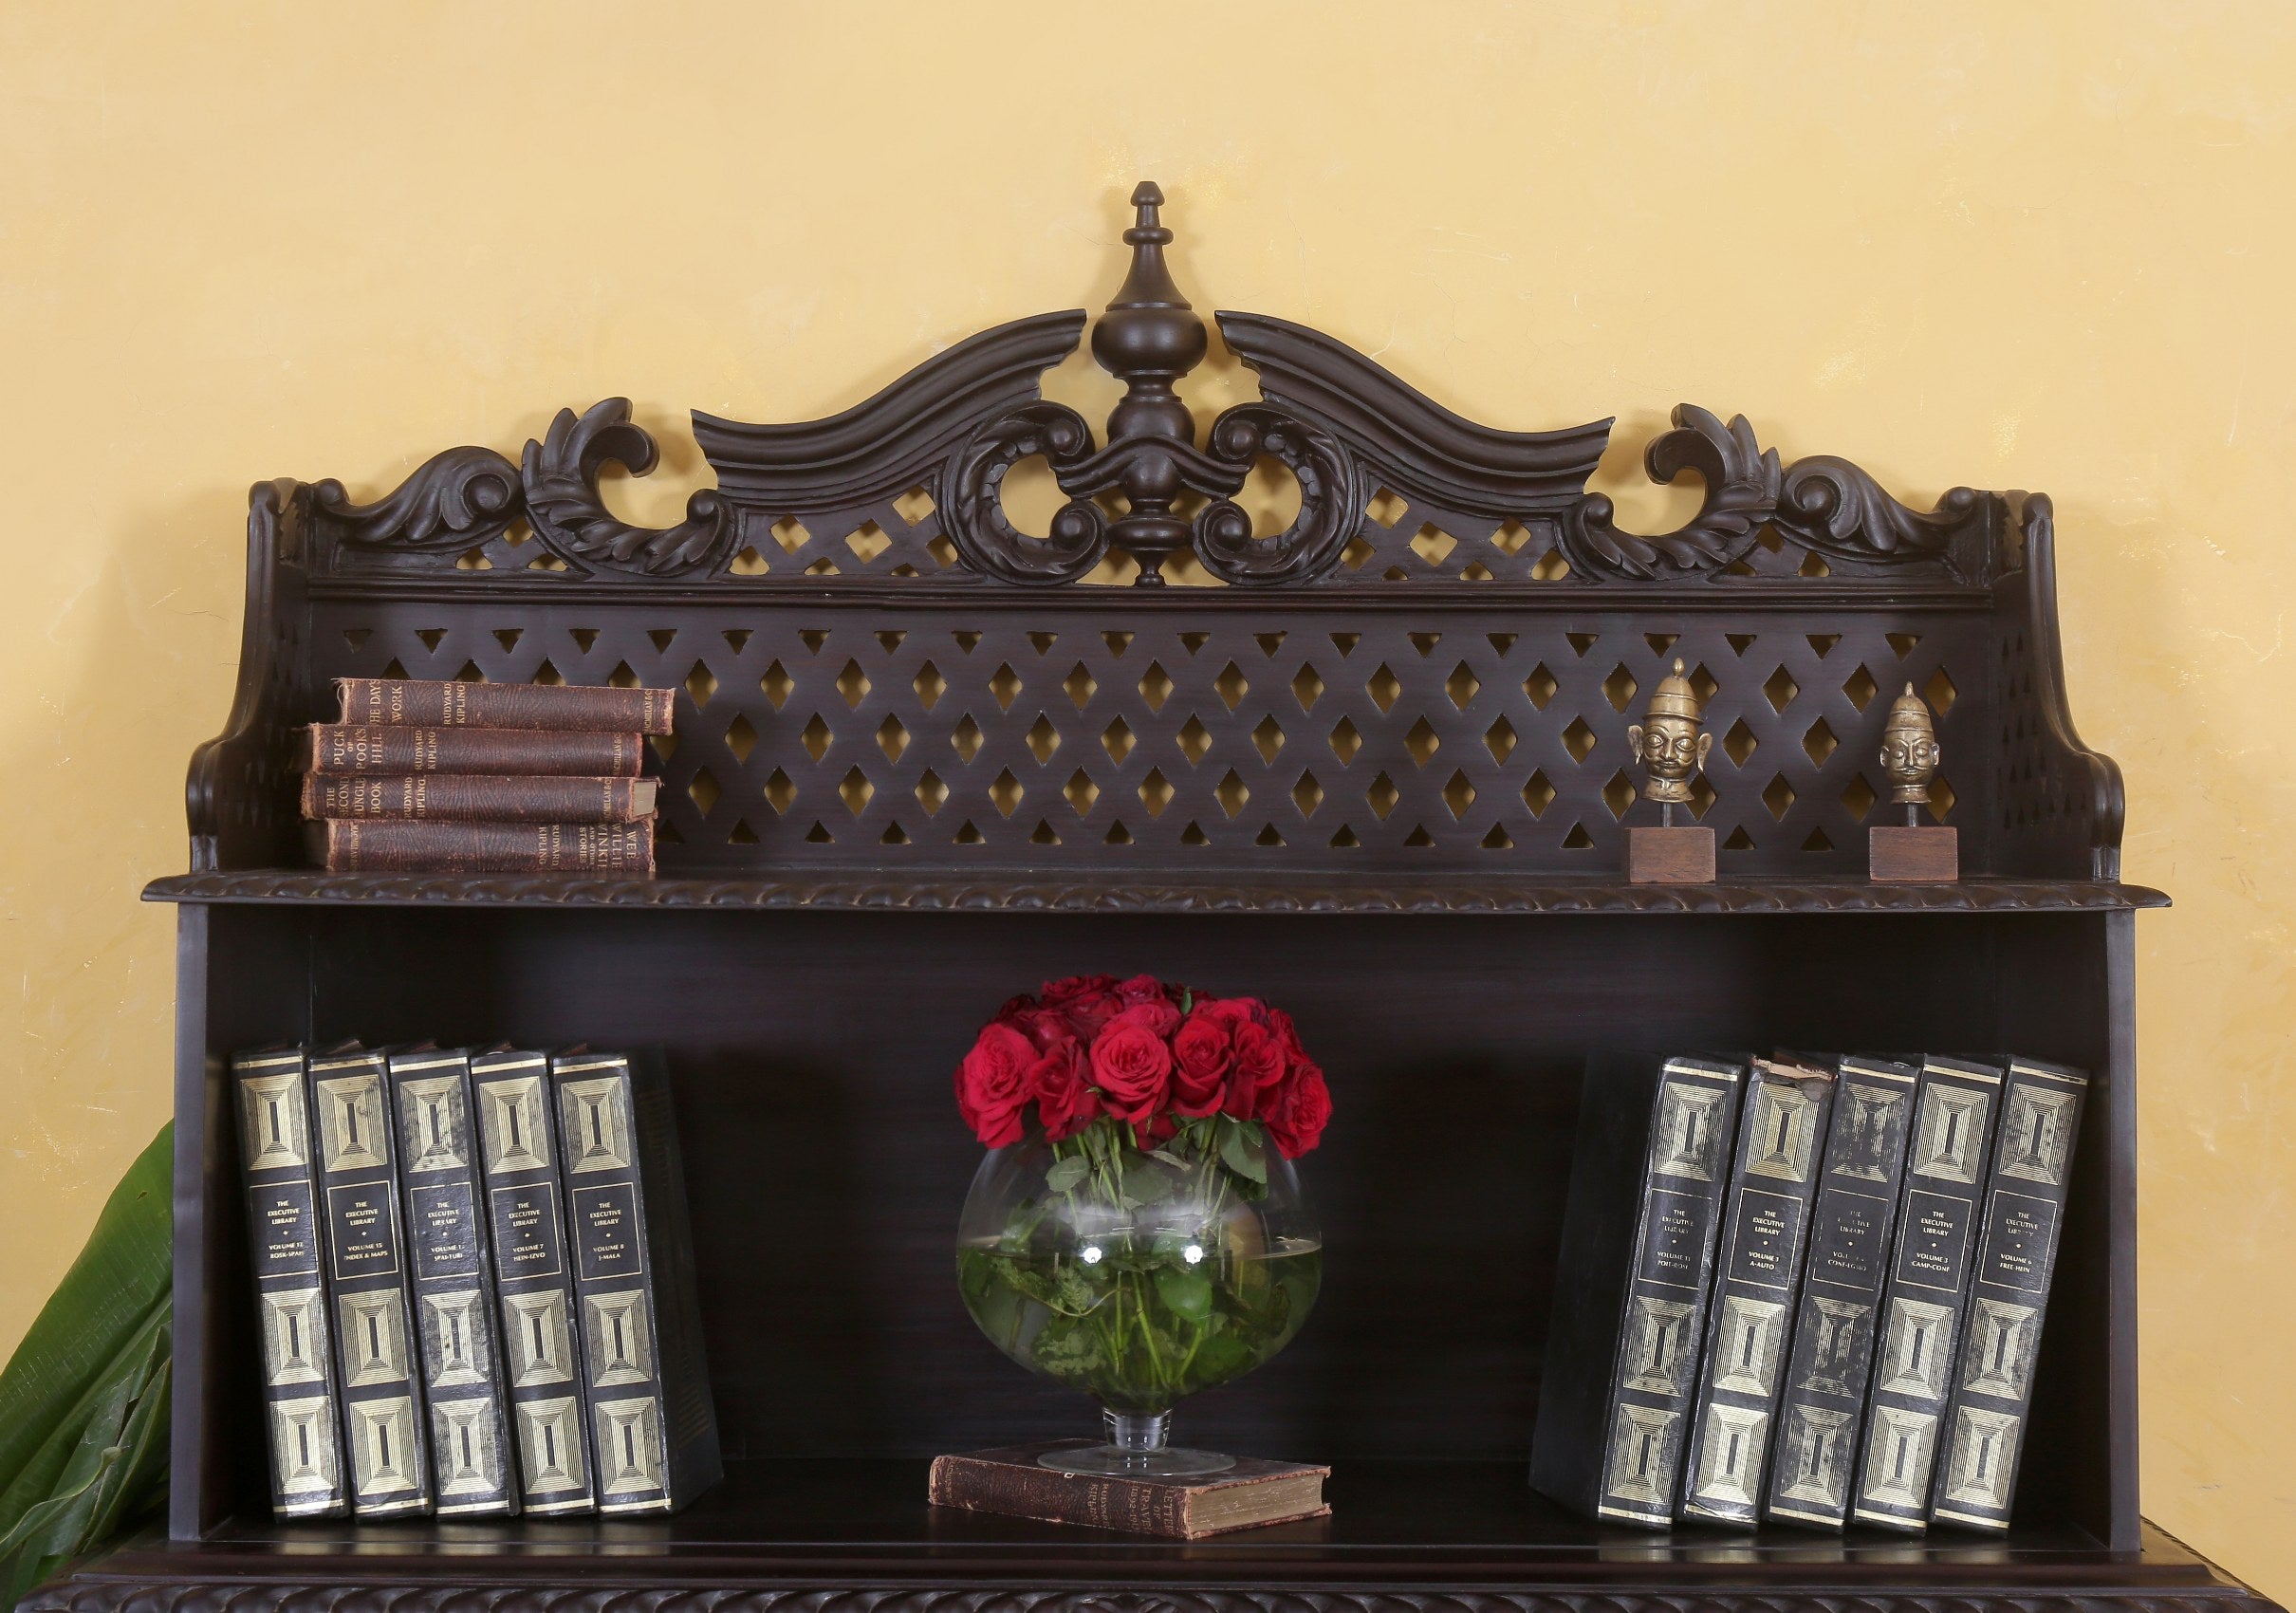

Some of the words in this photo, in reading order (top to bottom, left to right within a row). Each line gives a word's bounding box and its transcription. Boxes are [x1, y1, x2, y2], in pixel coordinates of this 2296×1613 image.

[391, 685, 402, 722] WORK
[443, 683, 452, 725] RUDYARD
[456, 682, 465, 724] KIPLING
[369, 708, 380, 723] HE
[333, 731, 344, 765] PUCK
[355, 728, 367, 769] POOK'S
[371, 733, 382, 764] HILL
[414, 730, 423, 770] RUDYARD
[427, 732, 437, 769] KIPLING
[326, 788, 335, 807] THE
[339, 777, 349, 817] SECOND
[370, 781, 381, 813] BOOK
[403, 777, 413, 818] RUDYARD
[417, 779, 426, 818] KIPLING
[538, 826, 547, 865] KIPLING
[551, 825, 560, 866] RUDYARD
[579, 827, 587, 863] STORIES
[612, 824, 622, 868] WILLIE
[626, 831, 637, 859] WEE
[268, 1208, 300, 1216] EXECUTIVE
[345, 1209, 379, 1217] EXECUTIVE
[428, 1209, 459, 1218] EXECUTIVE
[509, 1210, 541, 1218] EXECUTIVE
[589, 1209, 621, 1218] EXECUTIVE
[512, 1218, 538, 1227] LIBRARY
[1752, 1216, 1786, 1229] EXECUTIVE
[1920, 1218, 1953, 1229] EXECUTIVE
[2006, 1218, 2039, 1230] EXECUTIVE
[1754, 1226, 1781, 1236] LIBRARY
[1840, 1226, 1864, 1235] LIBRARY
[1923, 1227, 1949, 1236] LIBRARY
[343, 1252, 363, 1261] INDEX
[1657, 1251, 1683, 1260] VOLUME
[1749, 1251, 1775, 1261] VOLUME
[1916, 1252, 1943, 1262] VOLUME
[2000, 1253, 2027, 1263] VOLUME
[1750, 1261, 1775, 1270] A-AUTO
[1154, 1506, 1160, 1519] OF
